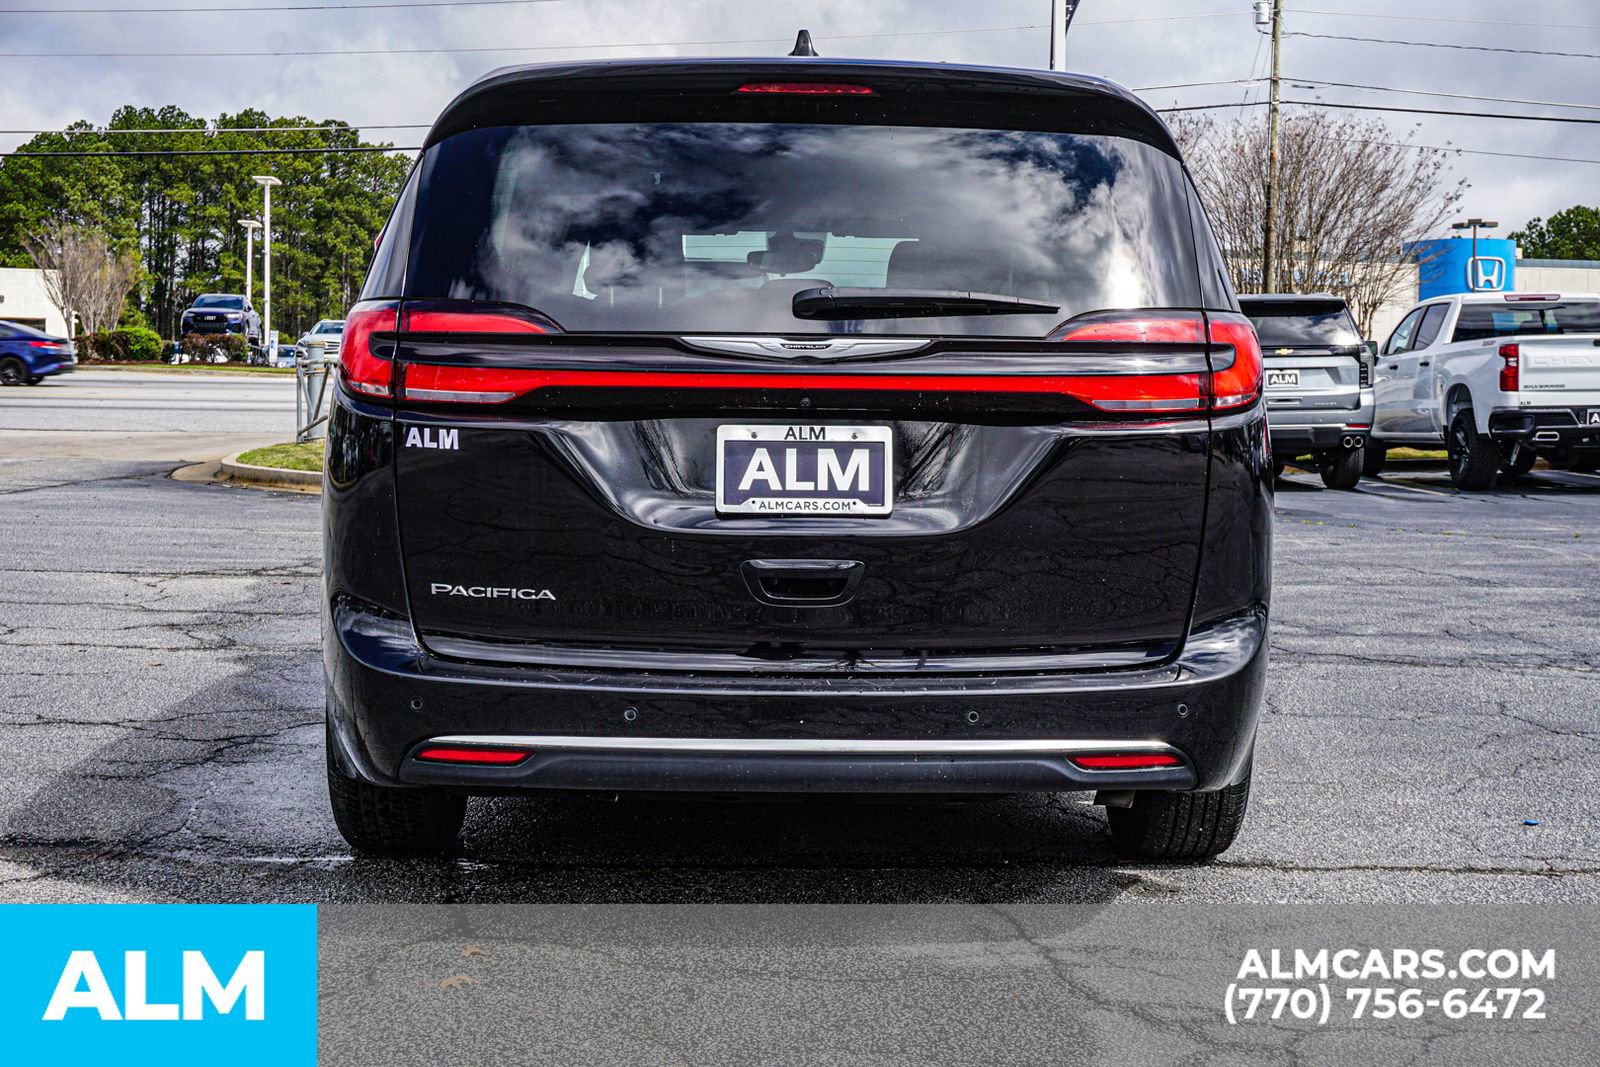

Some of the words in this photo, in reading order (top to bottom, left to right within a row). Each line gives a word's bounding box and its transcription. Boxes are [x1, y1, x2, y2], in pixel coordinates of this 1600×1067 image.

[1270, 374, 1296, 384] ALM
[405, 427, 459, 450] ALM
[784, 426, 826, 441] ALM
[738, 447, 870, 492] ALM
[758, 501, 851, 511] ALMCARS.COM
[430, 583, 556, 600] PACIFICA
